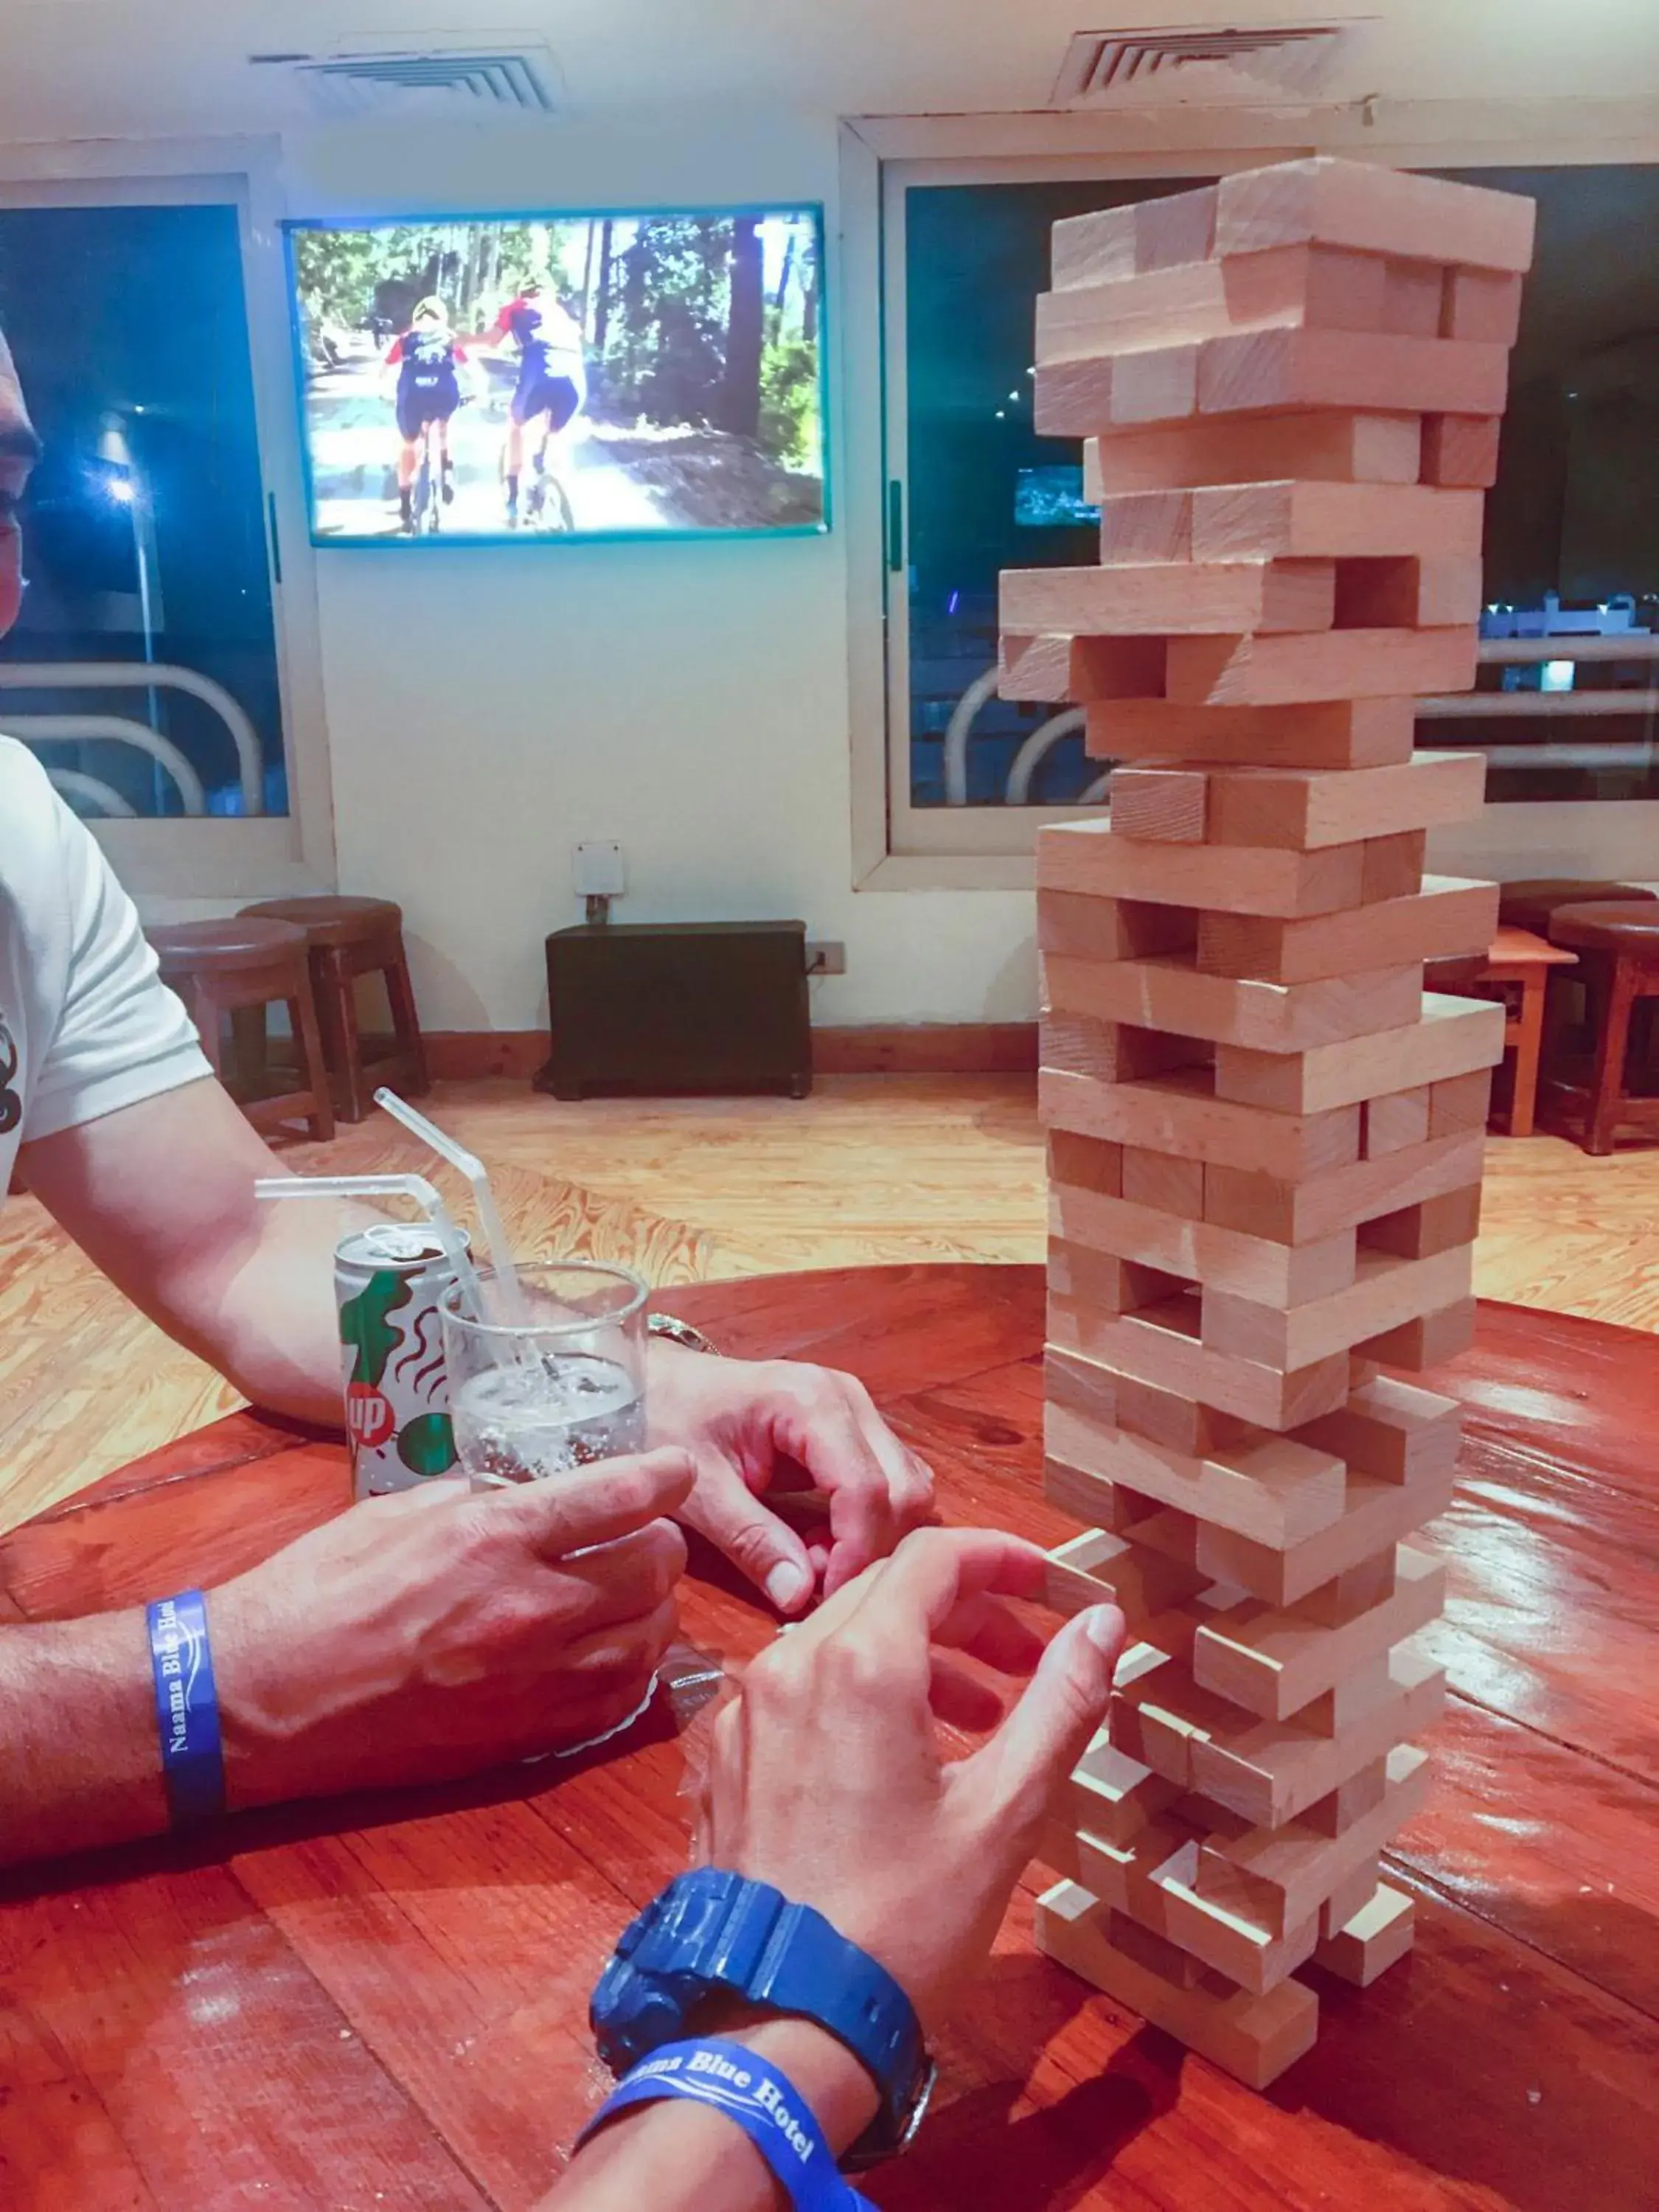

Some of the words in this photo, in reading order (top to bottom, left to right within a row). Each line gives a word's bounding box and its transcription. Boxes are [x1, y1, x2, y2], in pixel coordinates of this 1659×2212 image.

[169, 1679, 189, 1753] Naama
[686, 2051, 751, 2089] Blue
[752, 2079, 815, 2164] Hotel
